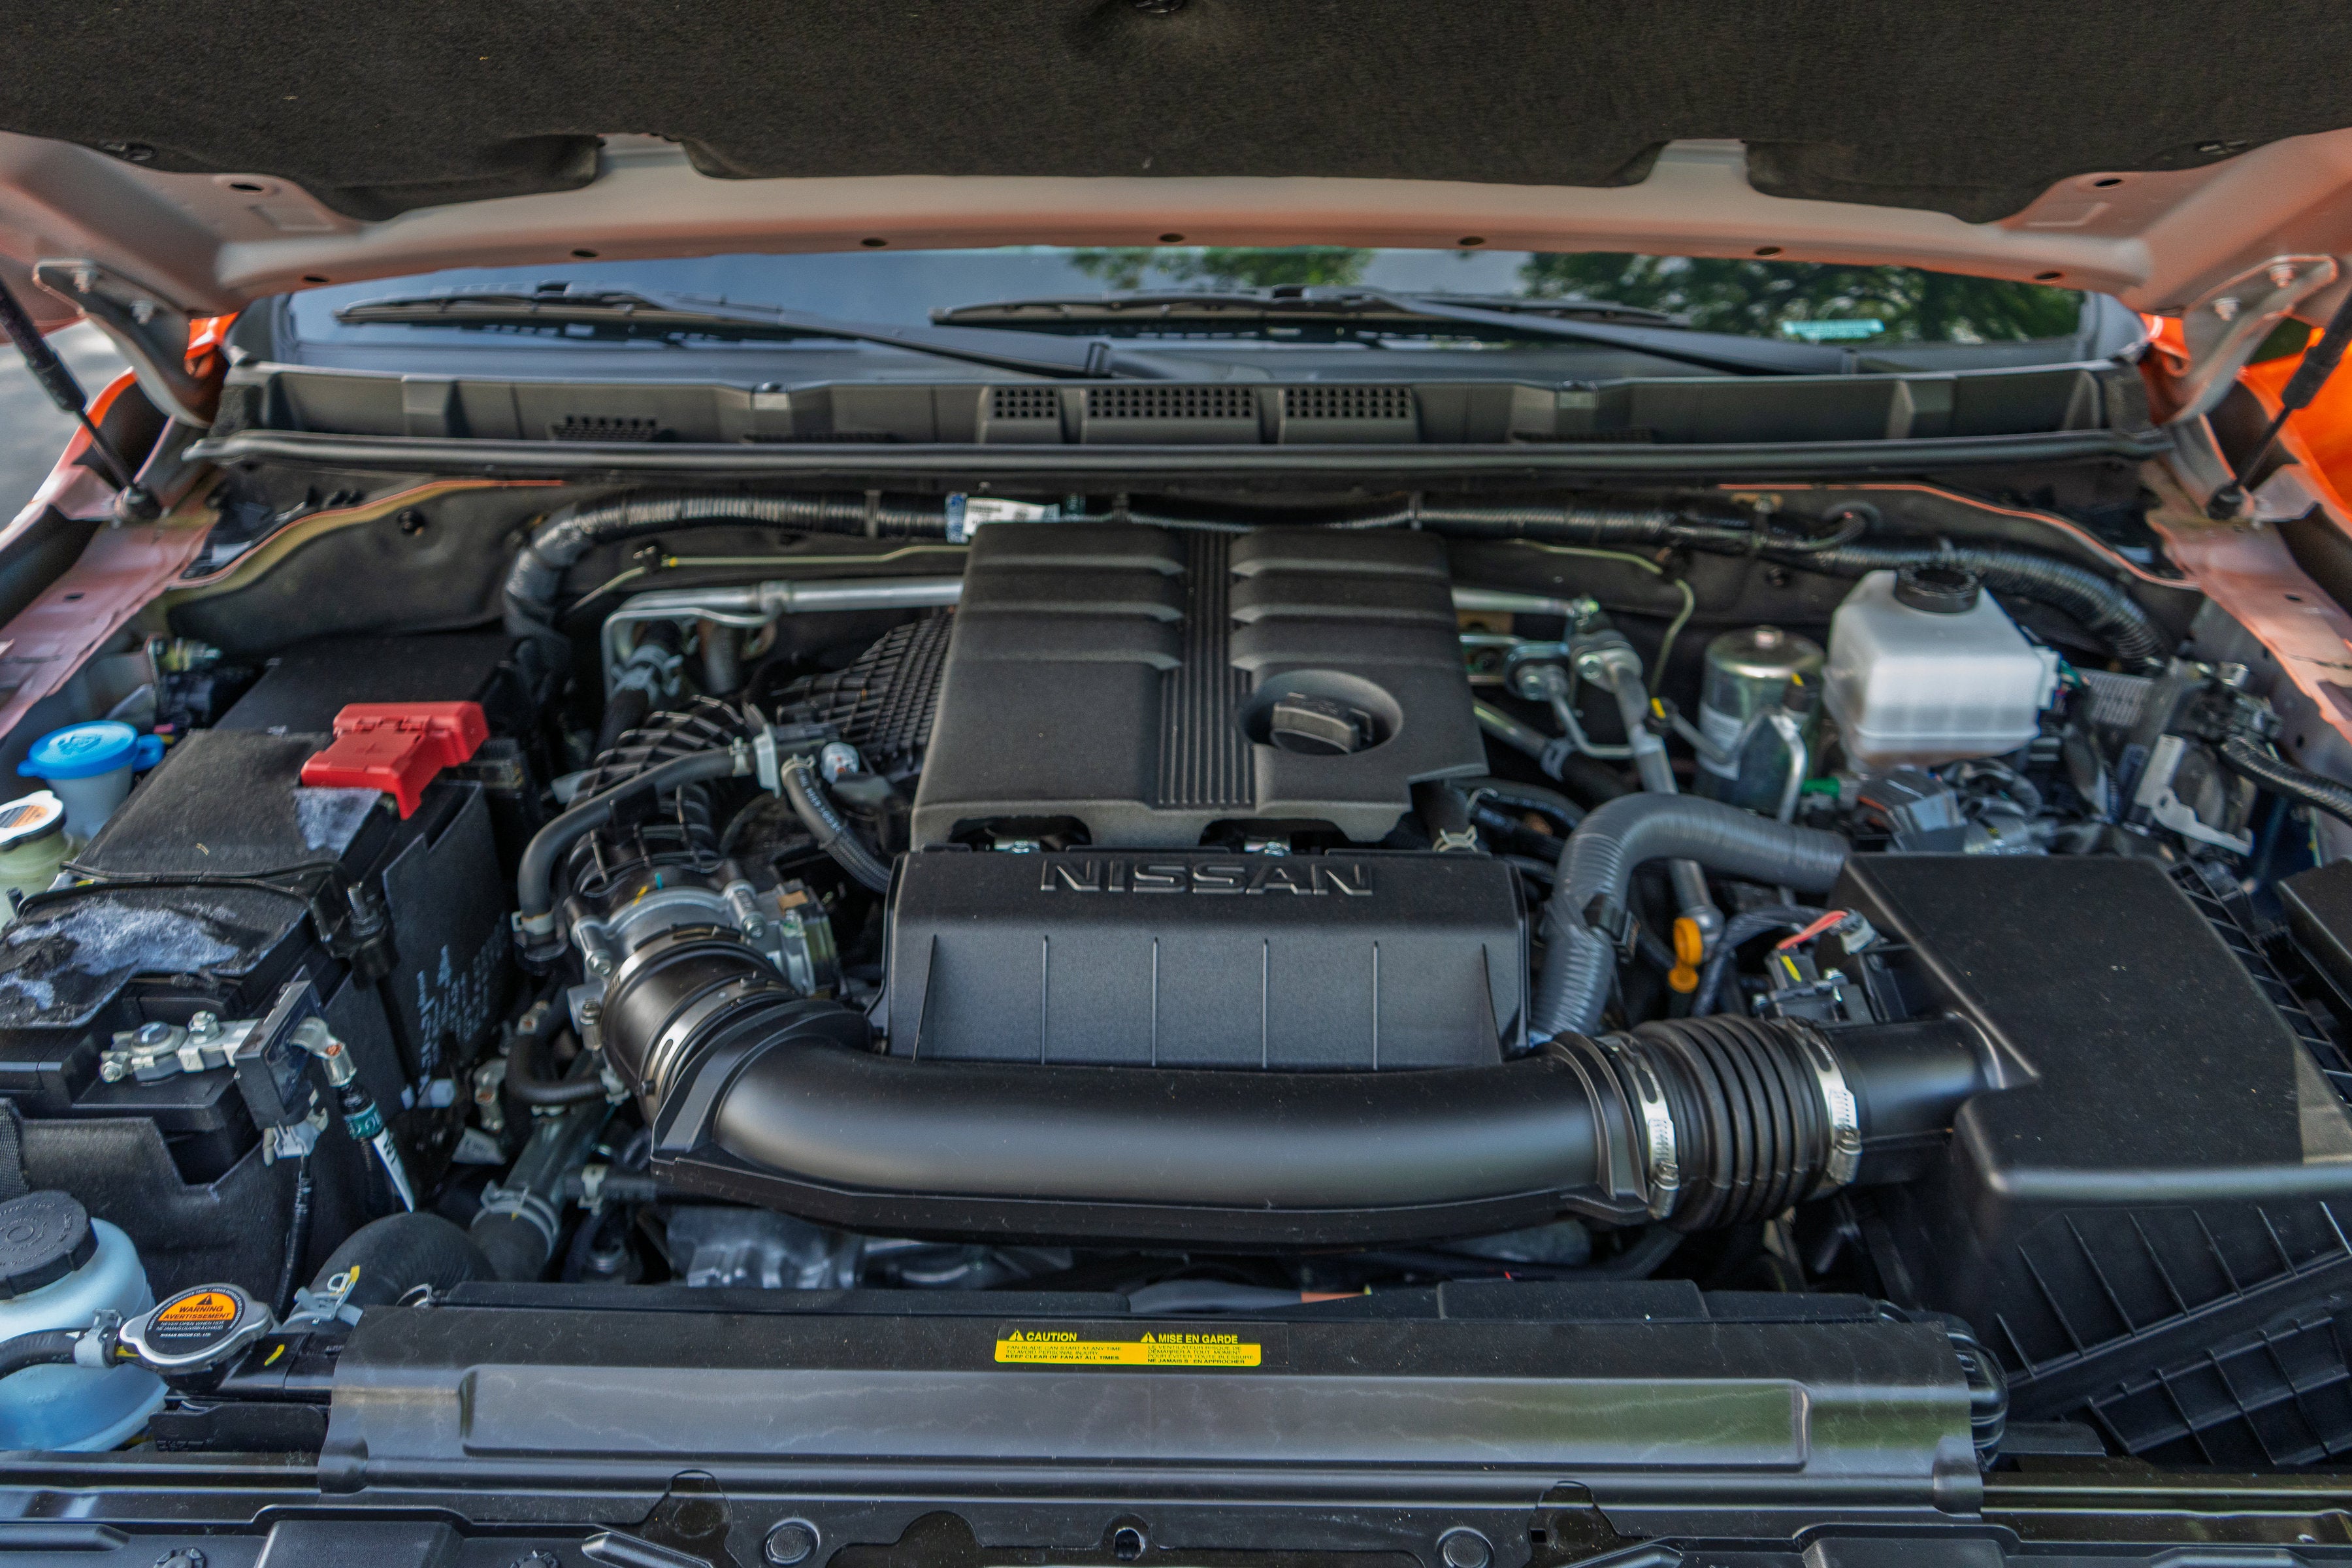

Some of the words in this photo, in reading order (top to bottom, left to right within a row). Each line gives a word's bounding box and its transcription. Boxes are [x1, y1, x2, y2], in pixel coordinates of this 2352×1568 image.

[1040, 859, 1374, 896] NISSAN
[1026, 1331, 1077, 1342] CAUTION
[1158, 1333, 1183, 1343] MISE
[1185, 1333, 1200, 1344] EN
[1201, 1333, 1238, 1345] GARDE
